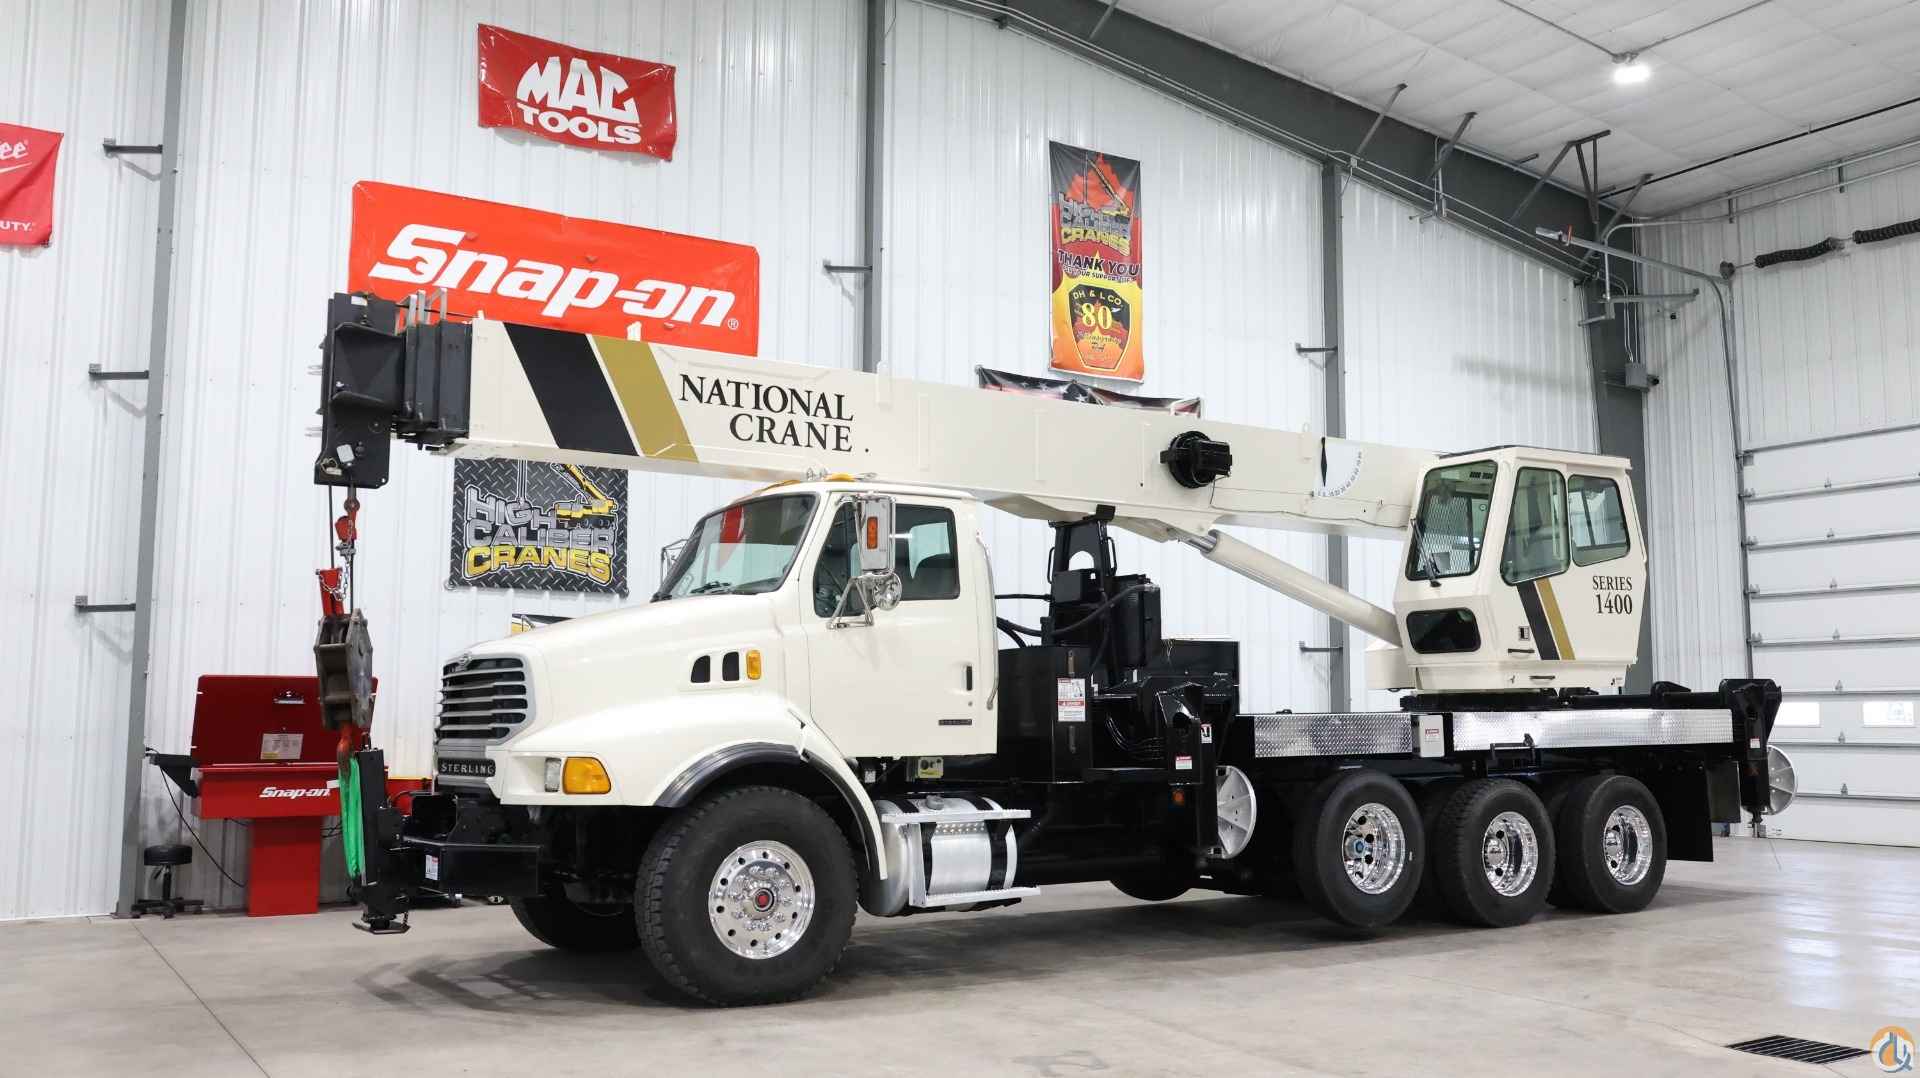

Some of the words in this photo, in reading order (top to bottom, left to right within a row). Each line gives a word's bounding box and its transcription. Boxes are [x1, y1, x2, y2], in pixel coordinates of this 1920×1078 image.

[516, 56, 640, 124] MAC
[516, 102, 642, 145] TOOLS
[1057, 248, 1104, 272] THANK
[1107, 260, 1140, 277] YOU
[1073, 290, 1085, 300] DH
[1099, 292, 1106, 300] L
[1081, 302, 1113, 330] 80
[679, 373, 854, 422] NATIONAL
[729, 413, 853, 453] CRANE
[466, 486, 558, 533] HIGH
[466, 518, 616, 558] CALIBER
[465, 545, 614, 585] CRANES
[1592, 575, 1633, 592] SERIES
[1595, 592, 1633, 615] 1400
[440, 763, 495, 775] STERLING
[259, 786, 331, 799] Snap-on
